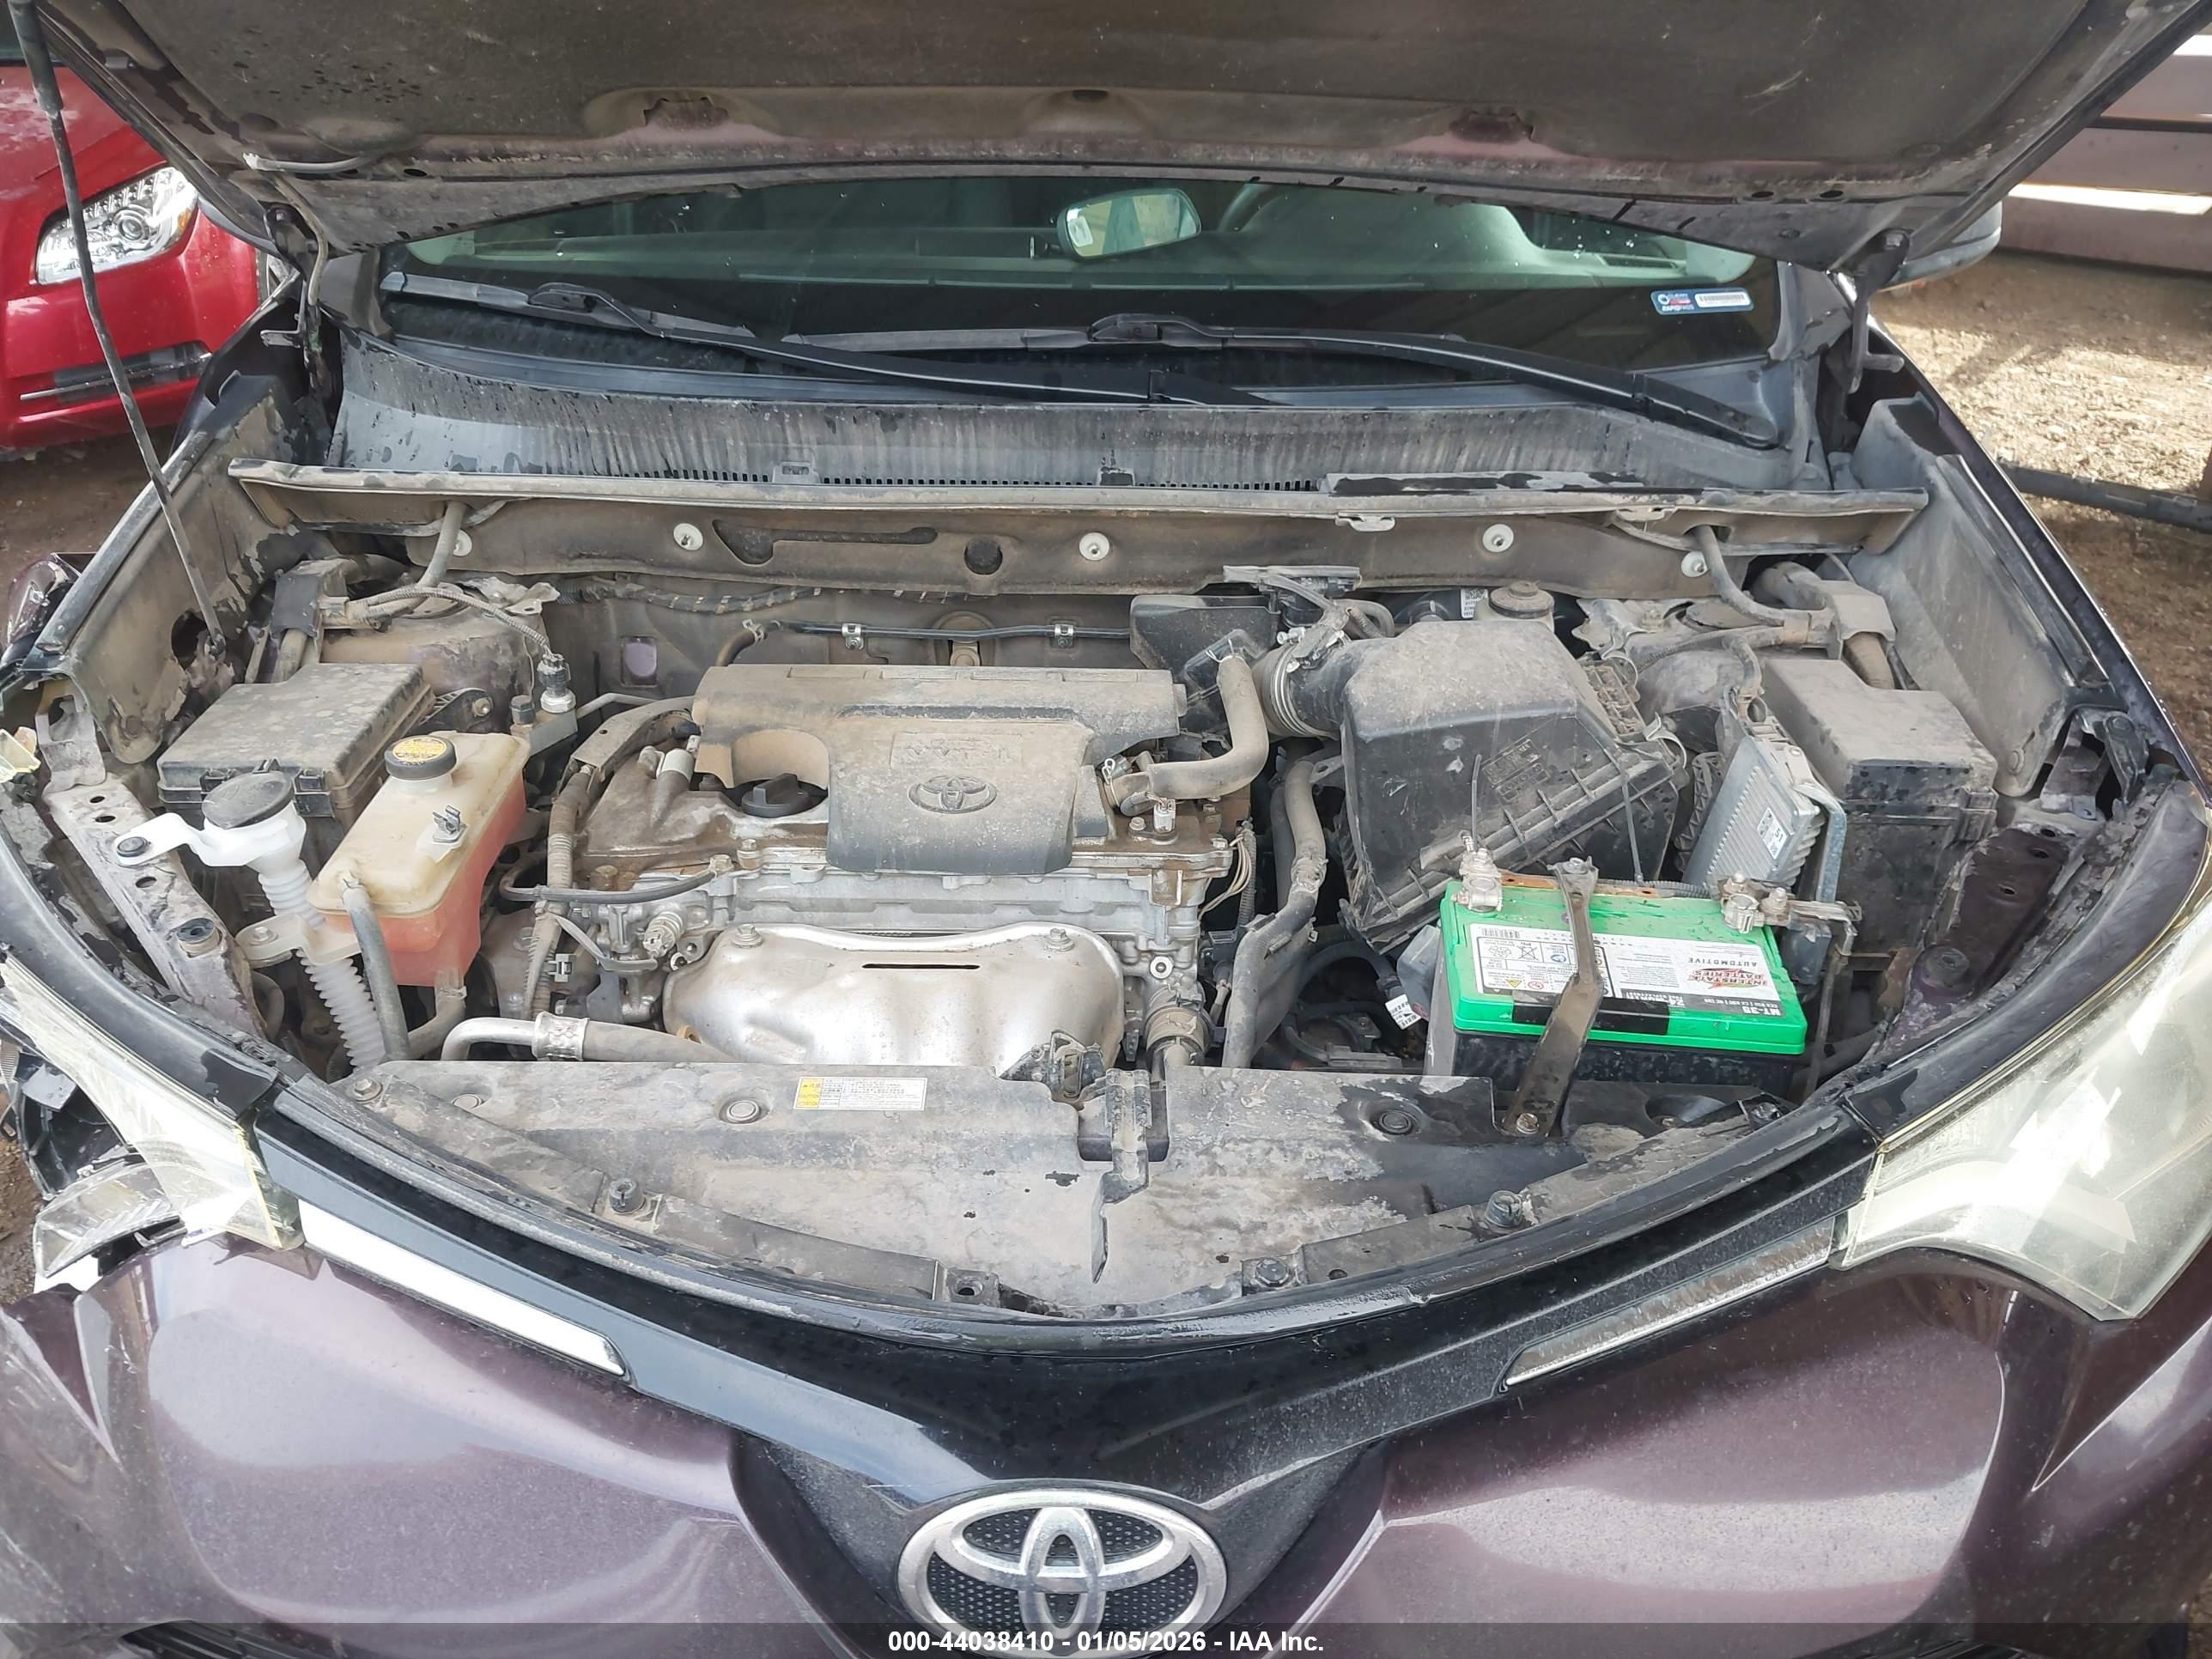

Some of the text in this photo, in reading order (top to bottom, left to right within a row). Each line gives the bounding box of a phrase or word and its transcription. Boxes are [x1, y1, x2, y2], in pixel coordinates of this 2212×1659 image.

[1687, 957, 1757, 968] AUTOMOTIVE
[1692, 969, 1764, 980] BATTERIES
[1687, 975, 1767, 987] INTERSTATE
